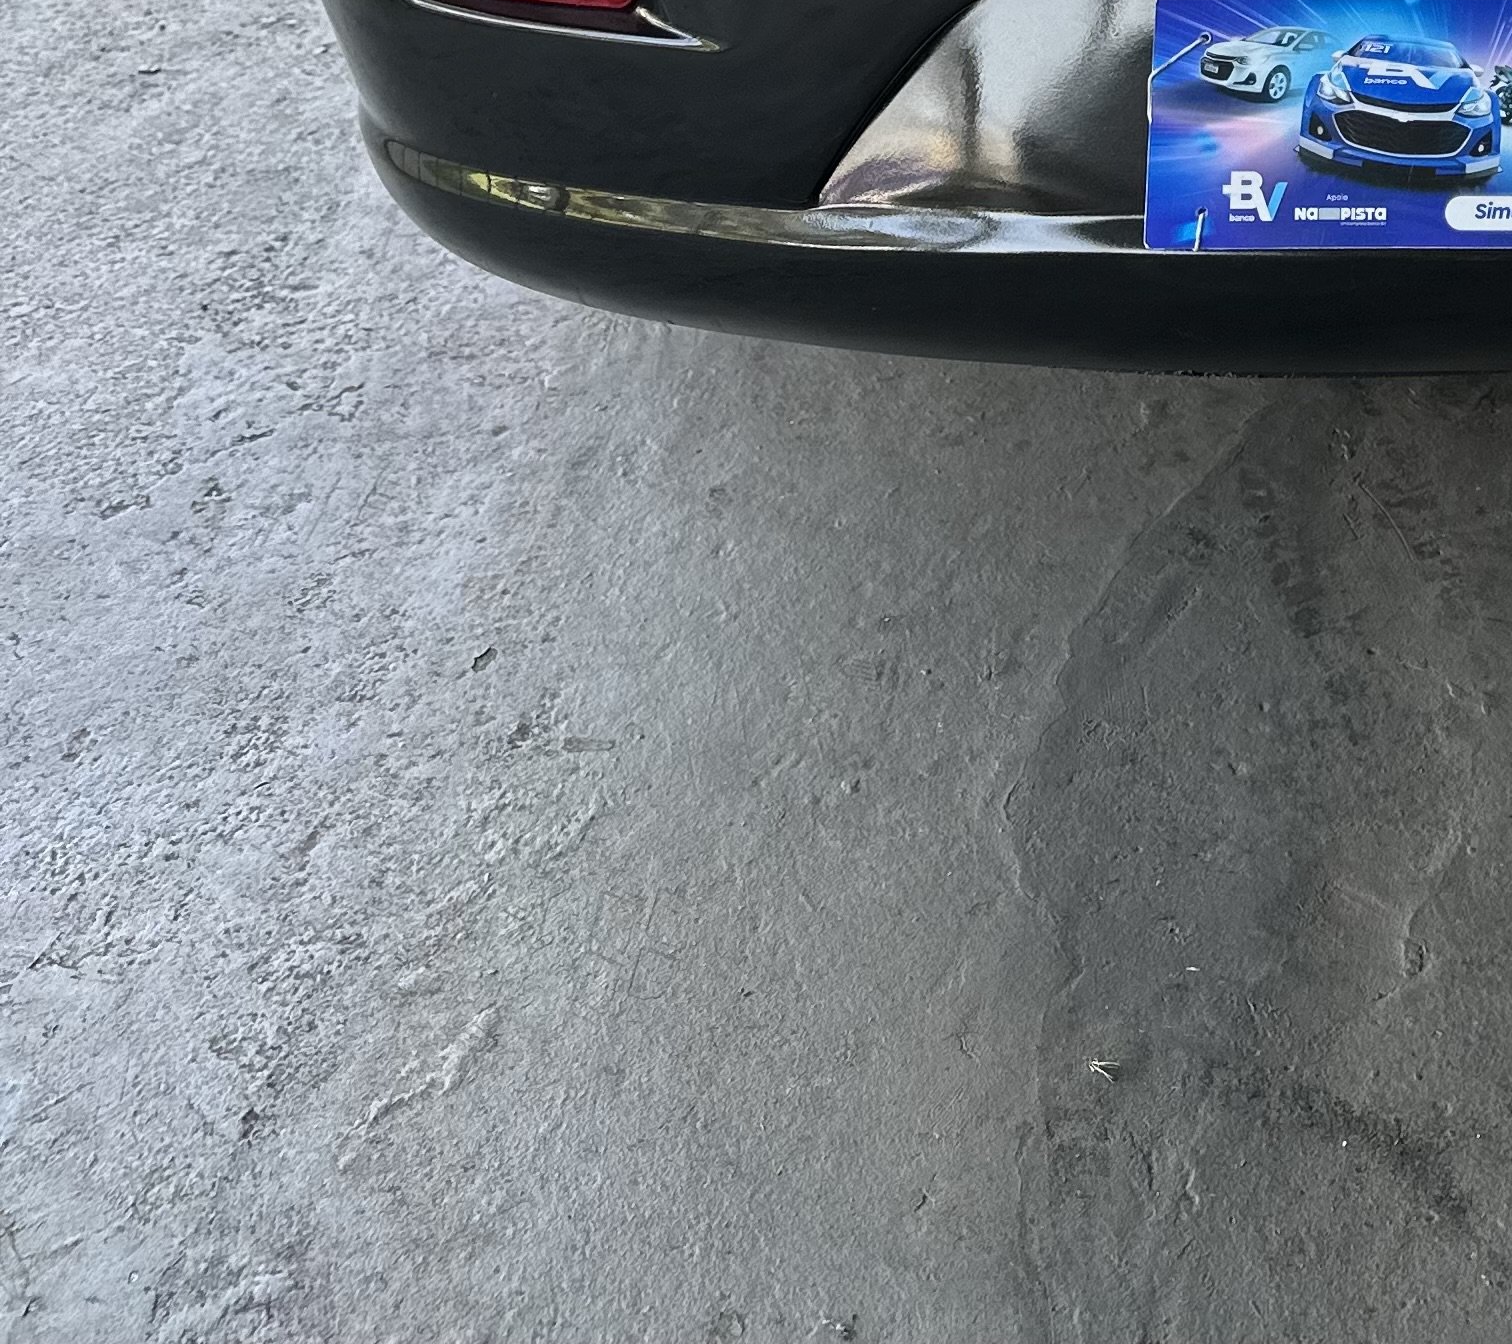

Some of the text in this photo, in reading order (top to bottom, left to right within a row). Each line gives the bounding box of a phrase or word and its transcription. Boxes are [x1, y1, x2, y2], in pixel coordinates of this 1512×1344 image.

[1363, 76, 1408, 86] banco
[1222, 170, 1288, 222] BV
[1325, 192, 1349, 202] Apoio
[1229, 212, 1256, 223] banco
